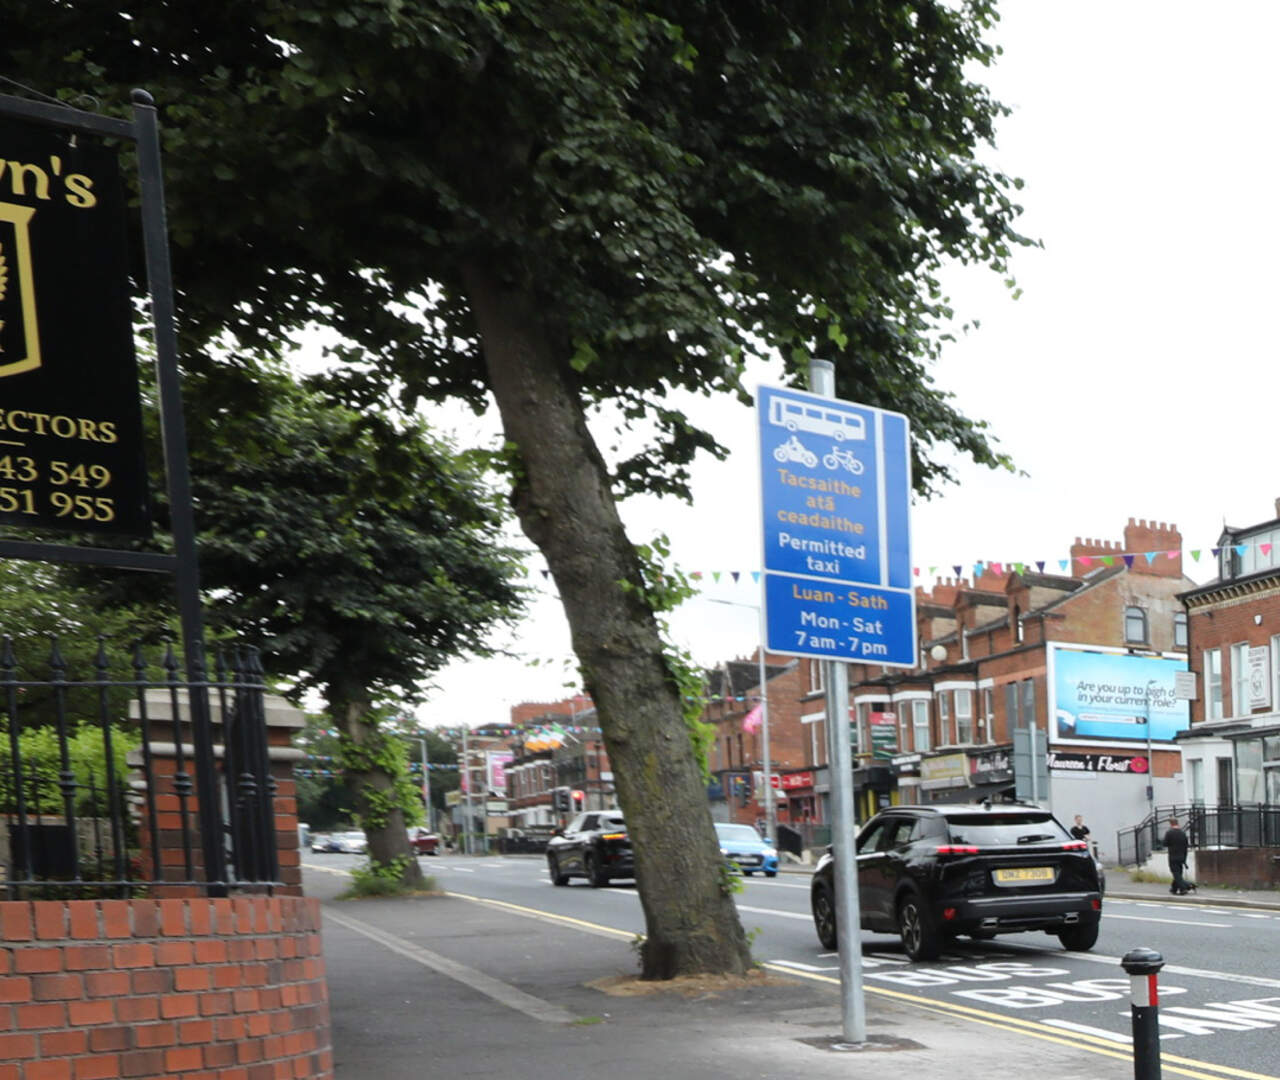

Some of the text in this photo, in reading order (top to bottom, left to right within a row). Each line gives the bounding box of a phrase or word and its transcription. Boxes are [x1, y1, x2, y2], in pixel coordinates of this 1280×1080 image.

[49, 460, 111, 489] 549
[777, 467, 862, 499] Tacsaithe
[50, 491, 115, 522] 955
[806, 494, 835, 512] atá
[777, 508, 864, 535] ceadaithe
[778, 531, 866, 560] Permitted
[807, 556, 840, 574] taxi
[792, 583, 834, 603] Luan
[848, 591, 888, 610] Sath
[800, 611, 839, 630] Mon
[853, 617, 883, 635] Sat
[1076, 680, 1094, 691] Are
[1096, 683, 1117, 696] you
[1117, 685, 1131, 697] up
[1133, 685, 1144, 695] to
[1077, 692, 1088, 702] in
[1089, 693, 1112, 707] your
[1097, 756, 1132, 772] Florist
[862, 961, 1071, 987] BUS
[951, 978, 1189, 1009] BUS
